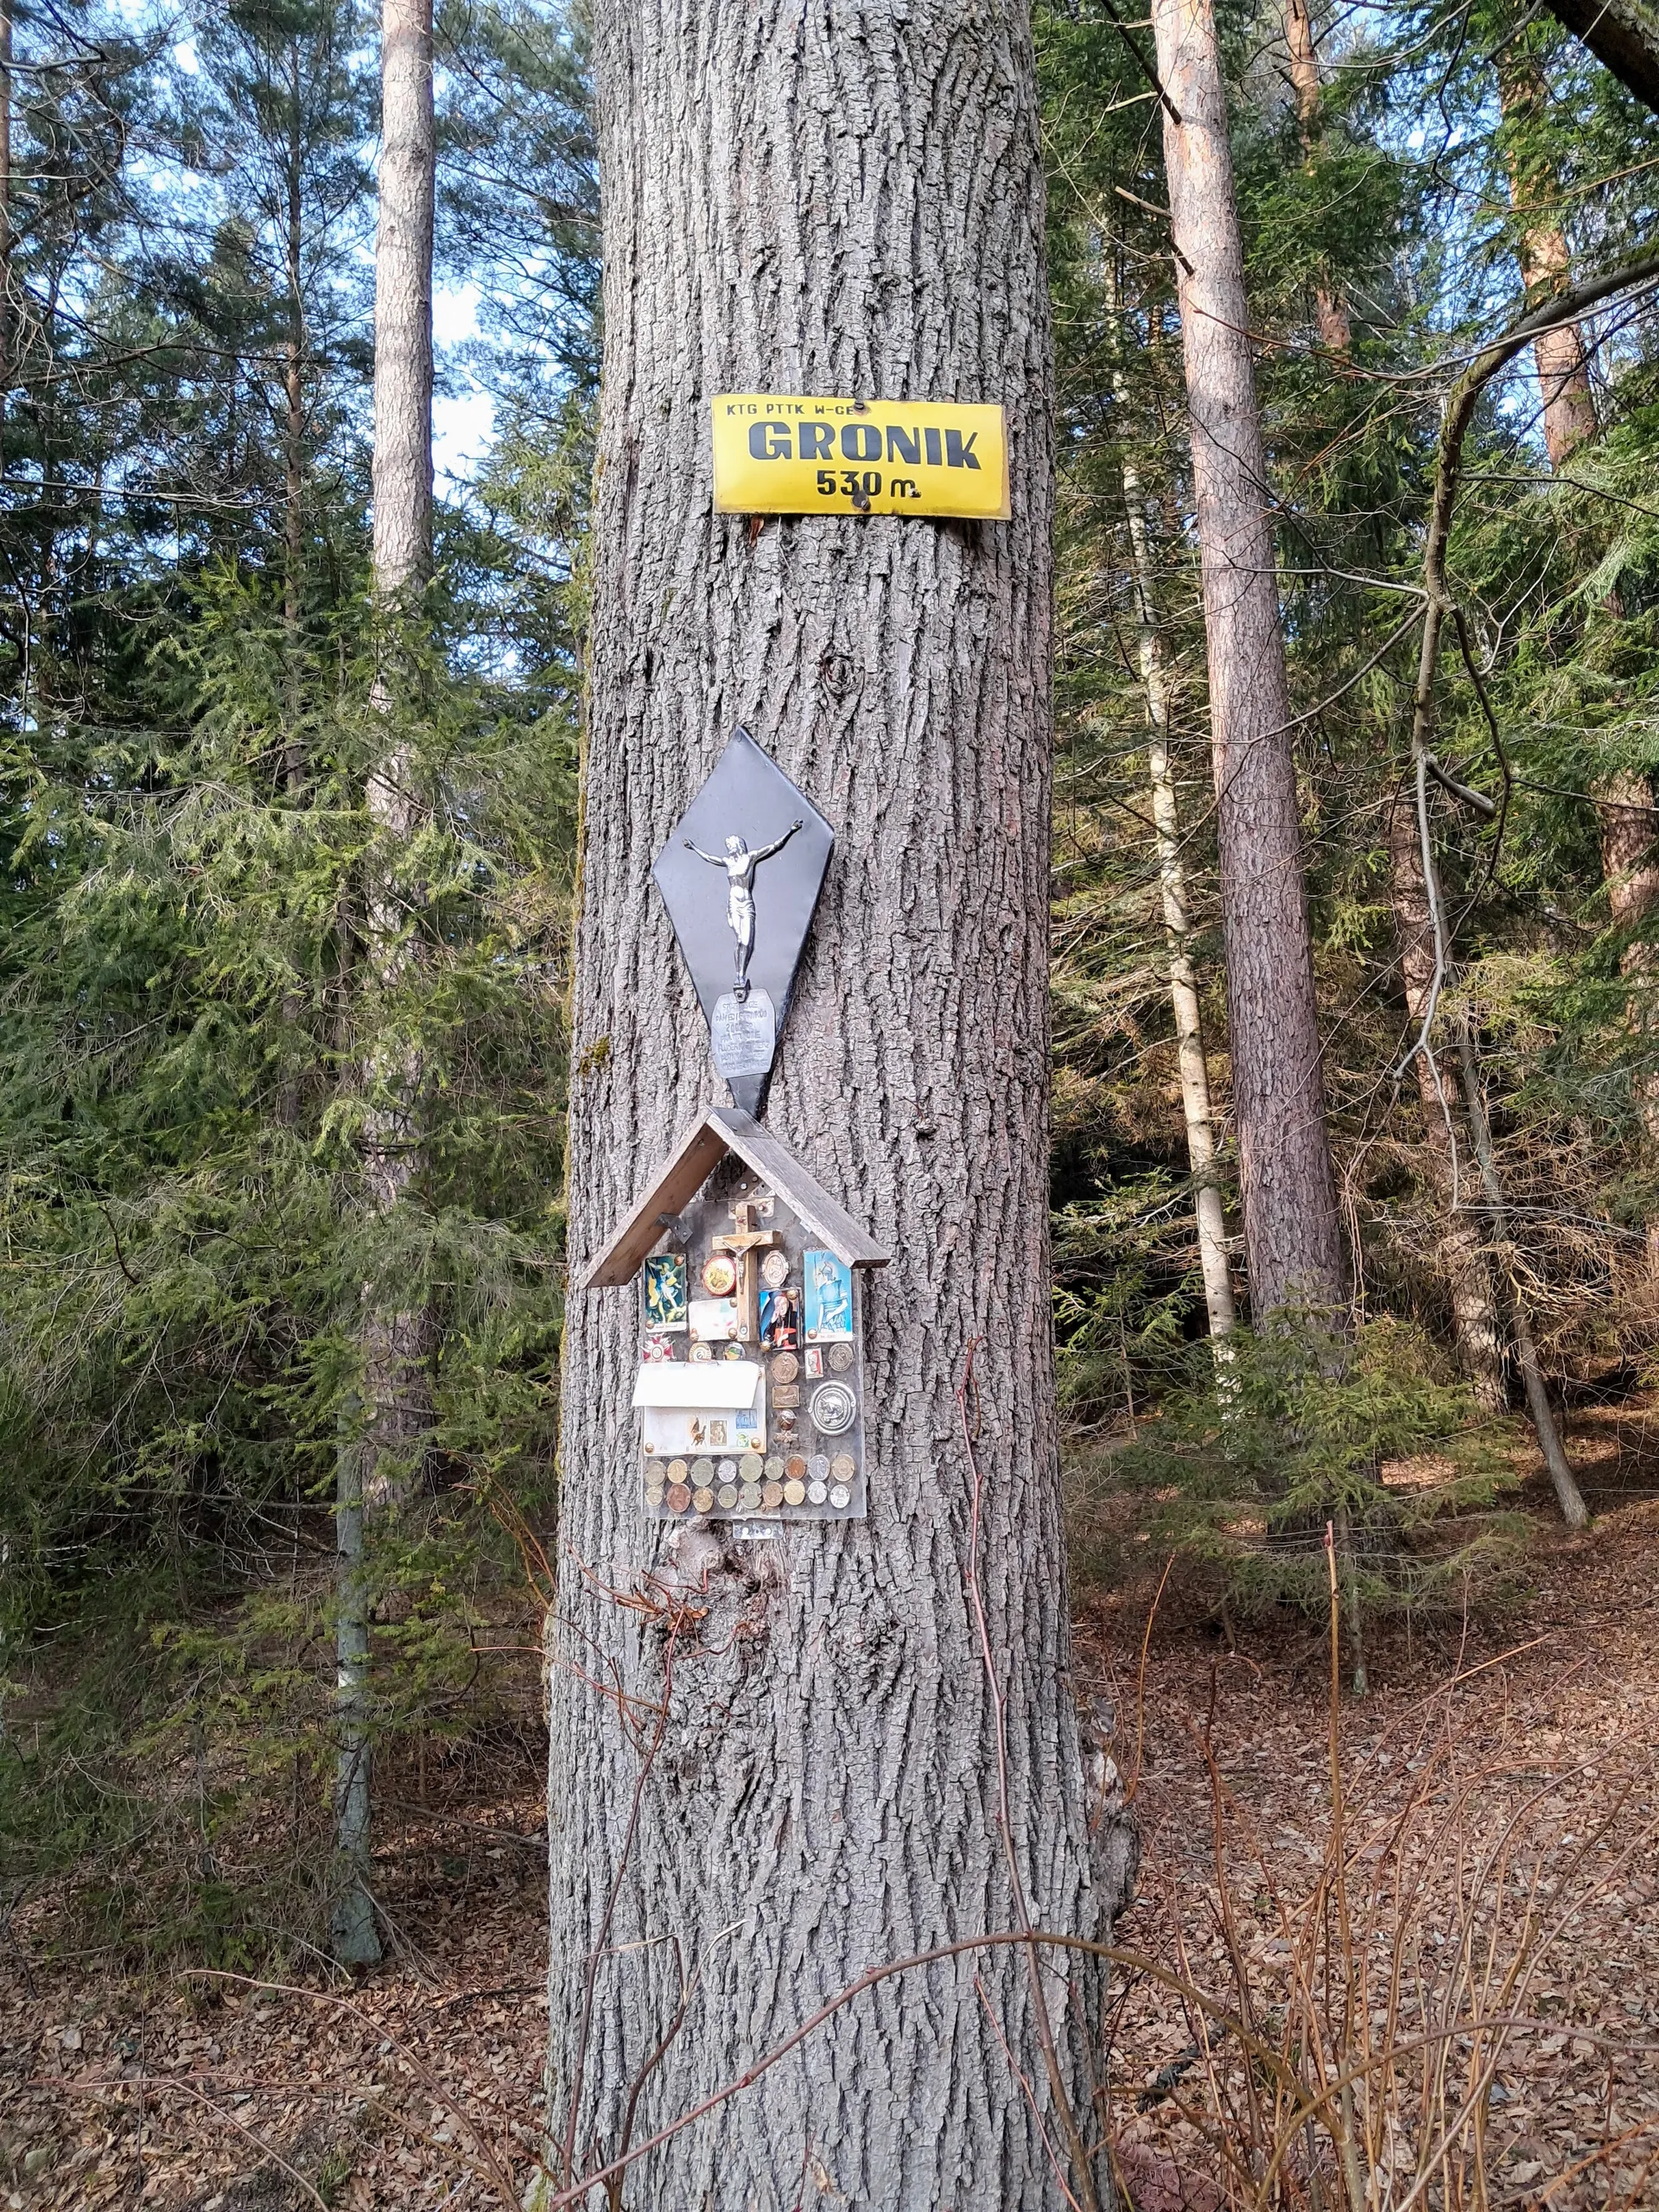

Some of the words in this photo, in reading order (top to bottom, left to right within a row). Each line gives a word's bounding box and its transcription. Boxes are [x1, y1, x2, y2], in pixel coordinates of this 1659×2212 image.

[727, 404, 758, 416] KTG
[766, 404, 805, 415] PTTK
[748, 421, 982, 470] GRONIK
[817, 469, 882, 497] 530
